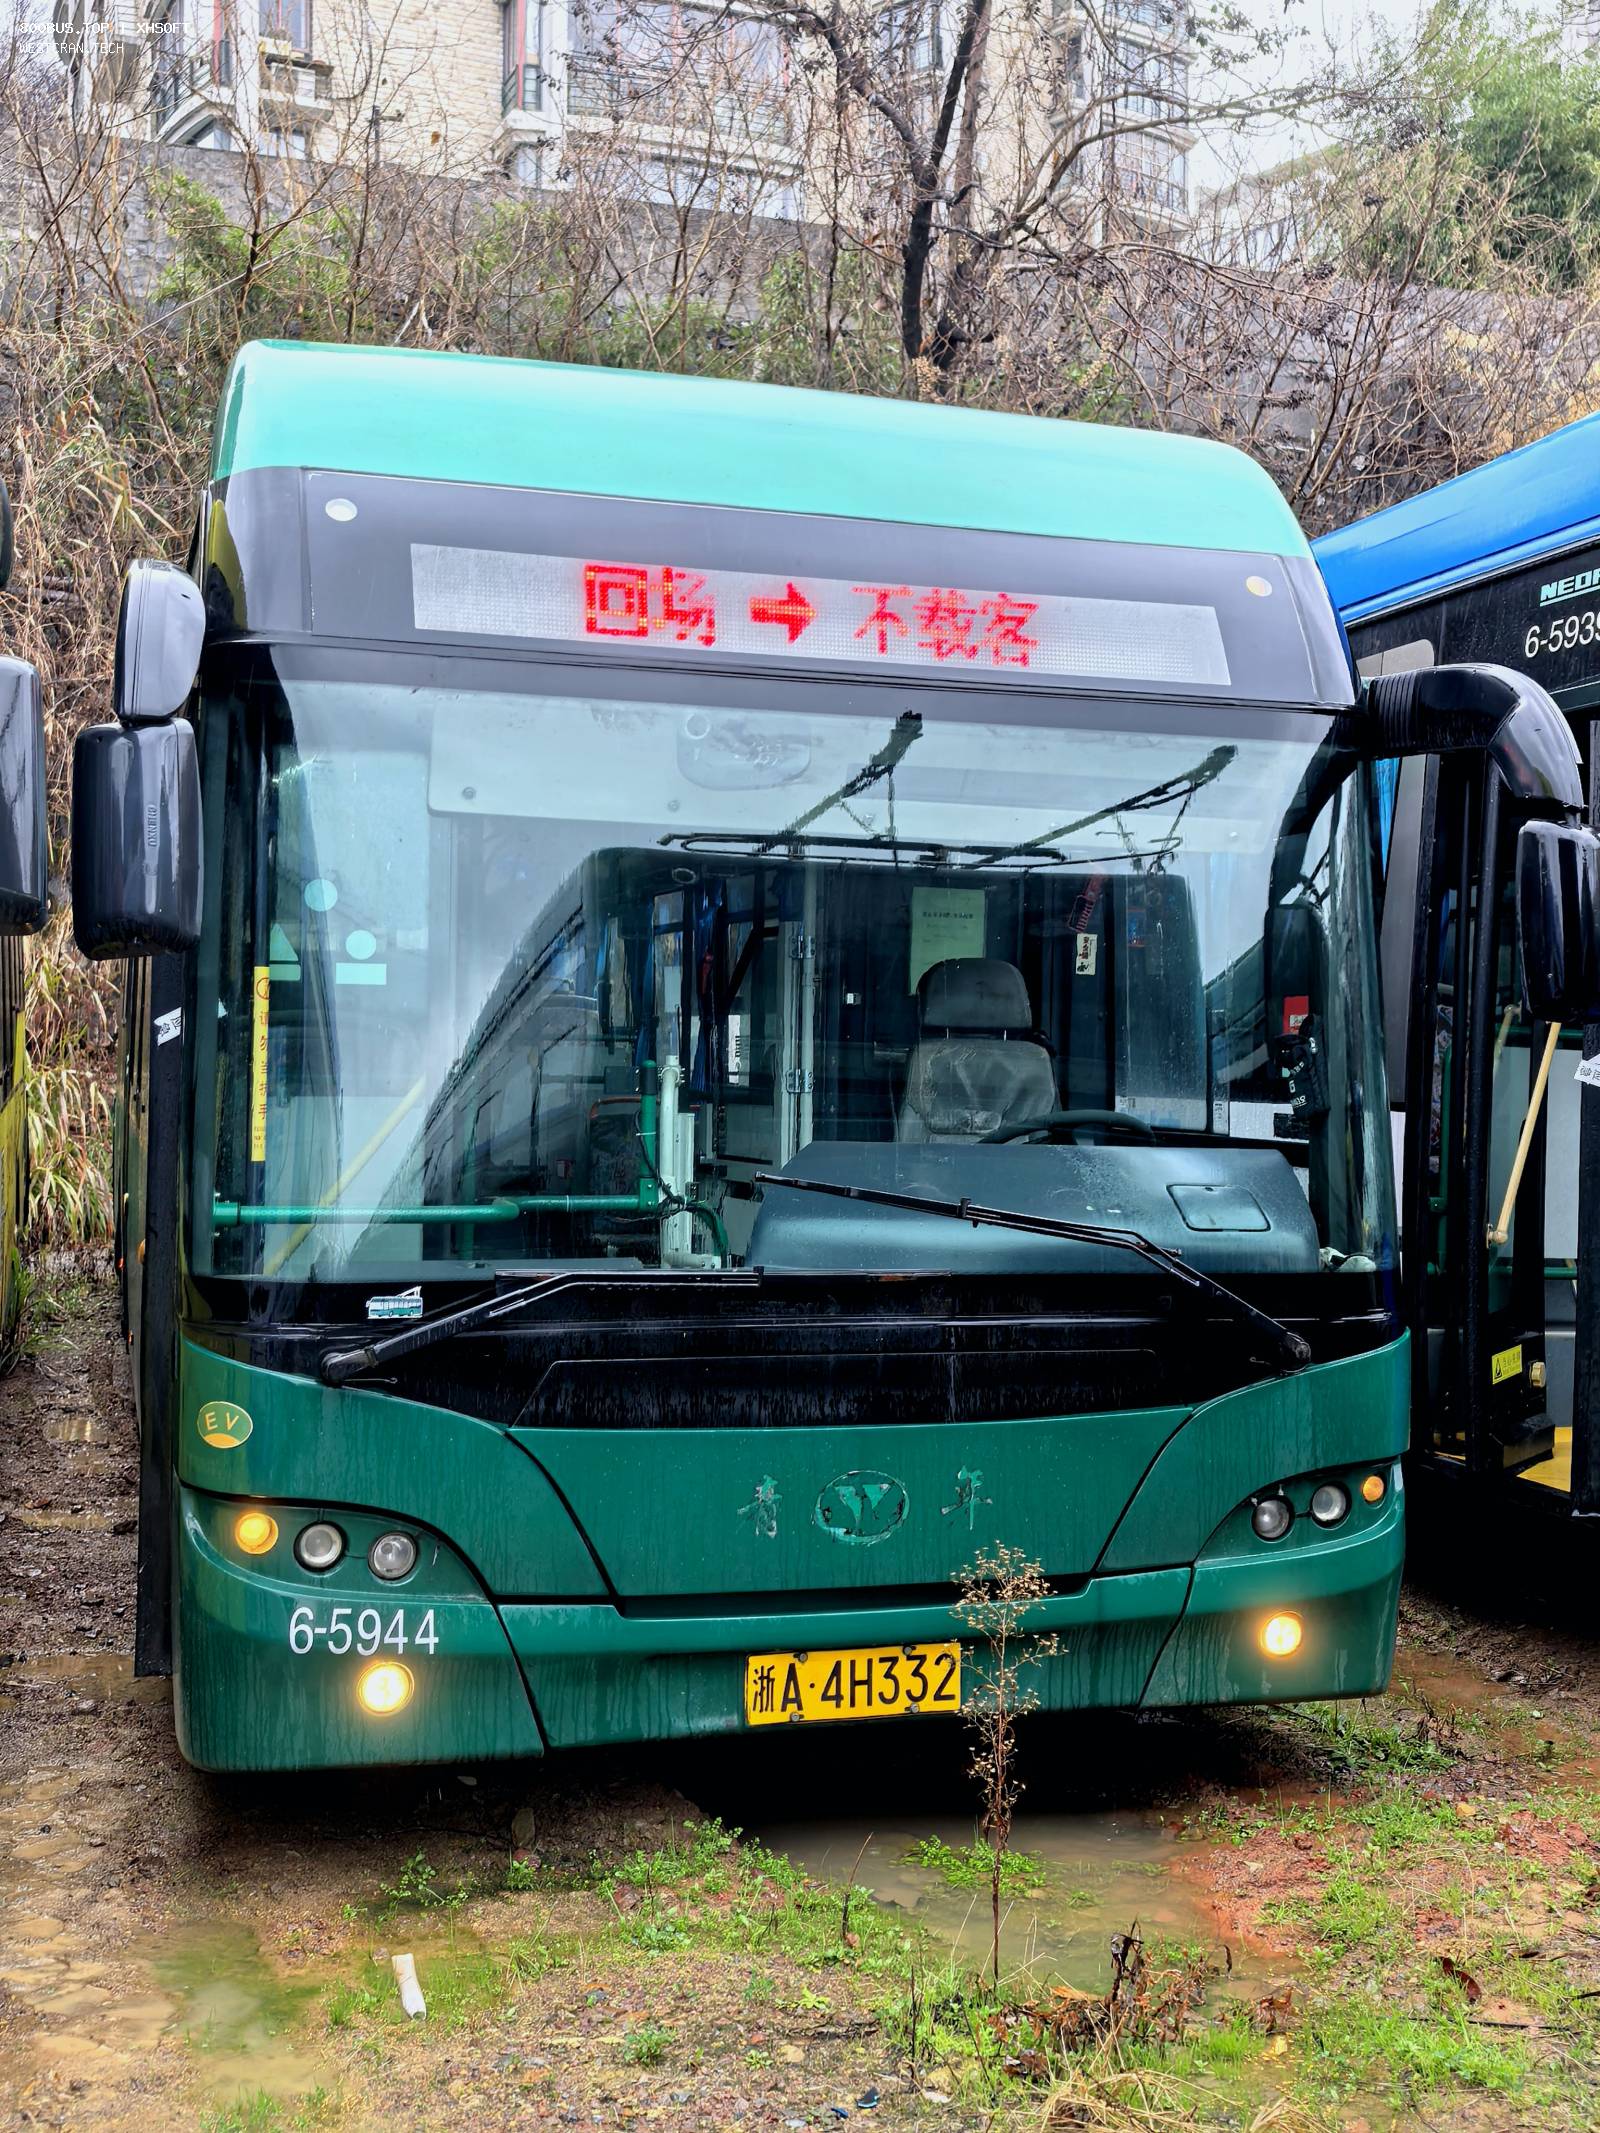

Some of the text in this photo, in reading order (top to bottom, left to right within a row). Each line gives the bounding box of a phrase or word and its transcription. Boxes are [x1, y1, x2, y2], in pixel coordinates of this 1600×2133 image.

[584, 562, 1040, 668] 回场 不载客
[204, 1412, 240, 1432] EV
[289, 1606, 439, 1656] 6-5944
[752, 1652, 956, 1713] 浙A·4H332
